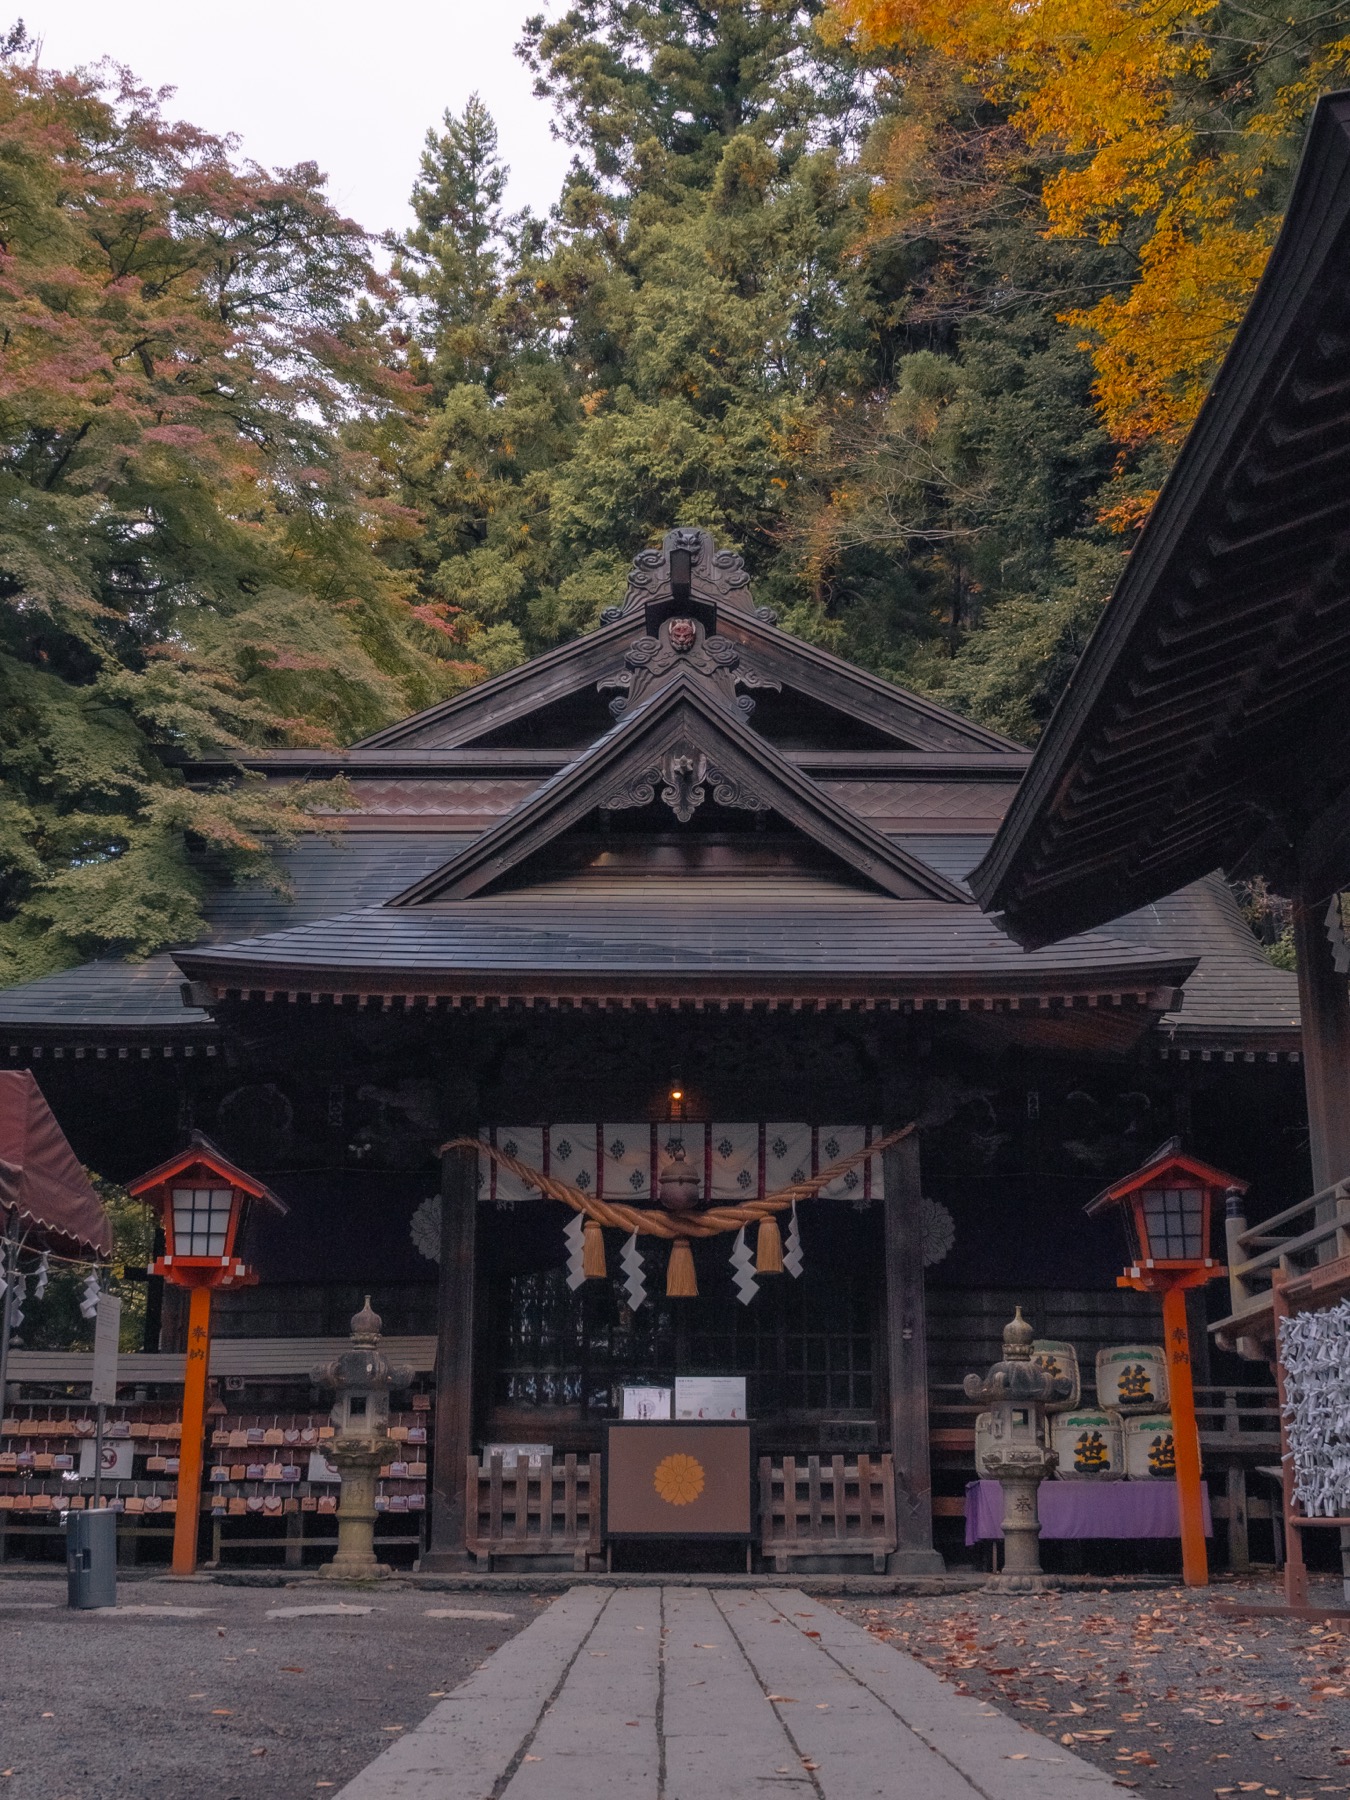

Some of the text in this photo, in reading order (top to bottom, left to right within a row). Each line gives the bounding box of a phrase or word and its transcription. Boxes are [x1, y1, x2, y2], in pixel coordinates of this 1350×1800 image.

[189, 1325, 207, 1361] 奉納
[1171, 1326, 1189, 1364] 奉納
[1013, 1494, 1034, 1515] 奉
